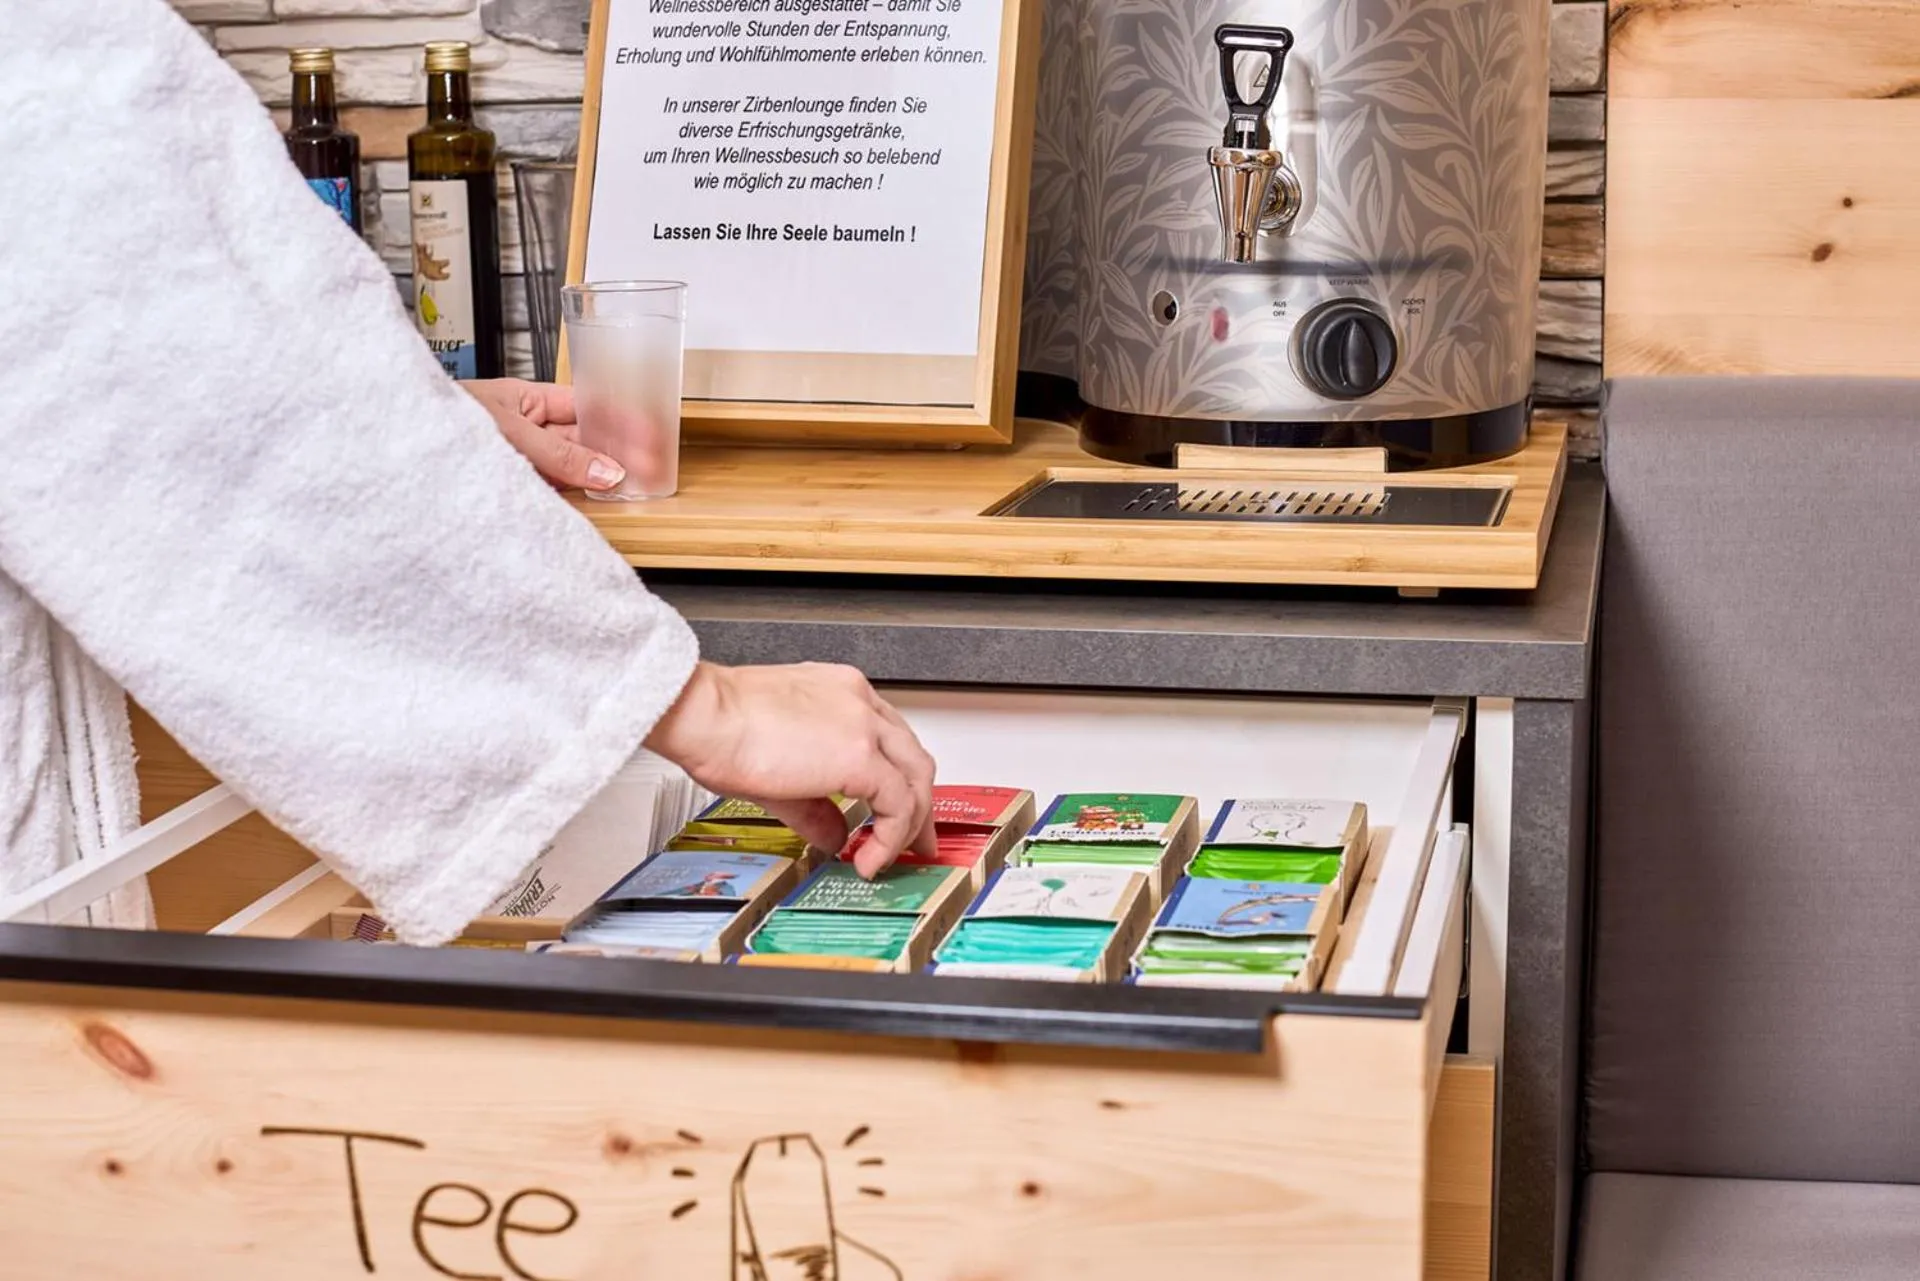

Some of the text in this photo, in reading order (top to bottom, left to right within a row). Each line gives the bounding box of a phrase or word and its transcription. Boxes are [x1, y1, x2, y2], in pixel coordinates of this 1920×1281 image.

[649, 0, 771, 14] Wellnessbereich
[773, 0, 871, 16] ausgestattet
[887, 0, 932, 13] damit
[935, 0, 962, 13] Sie
[652, 19, 951, 42] wundervolle Stunden der Entspannung,
[615, 44, 987, 68] Erholung und Wohlfühlmomente erleben können.
[662, 95, 928, 118] In unserer Zirbenlounge finden Sie
[678, 120, 905, 143] diverse Erfrischungsgetränke,
[642, 146, 942, 166] um Ihren Wellnessbesuch so belebend
[693, 171, 885, 194] wie möglich zu machen !
[652, 222, 917, 243] Lassen Sie Ihre Seele baumeln !
[262, 1125, 578, 1281] Tee
